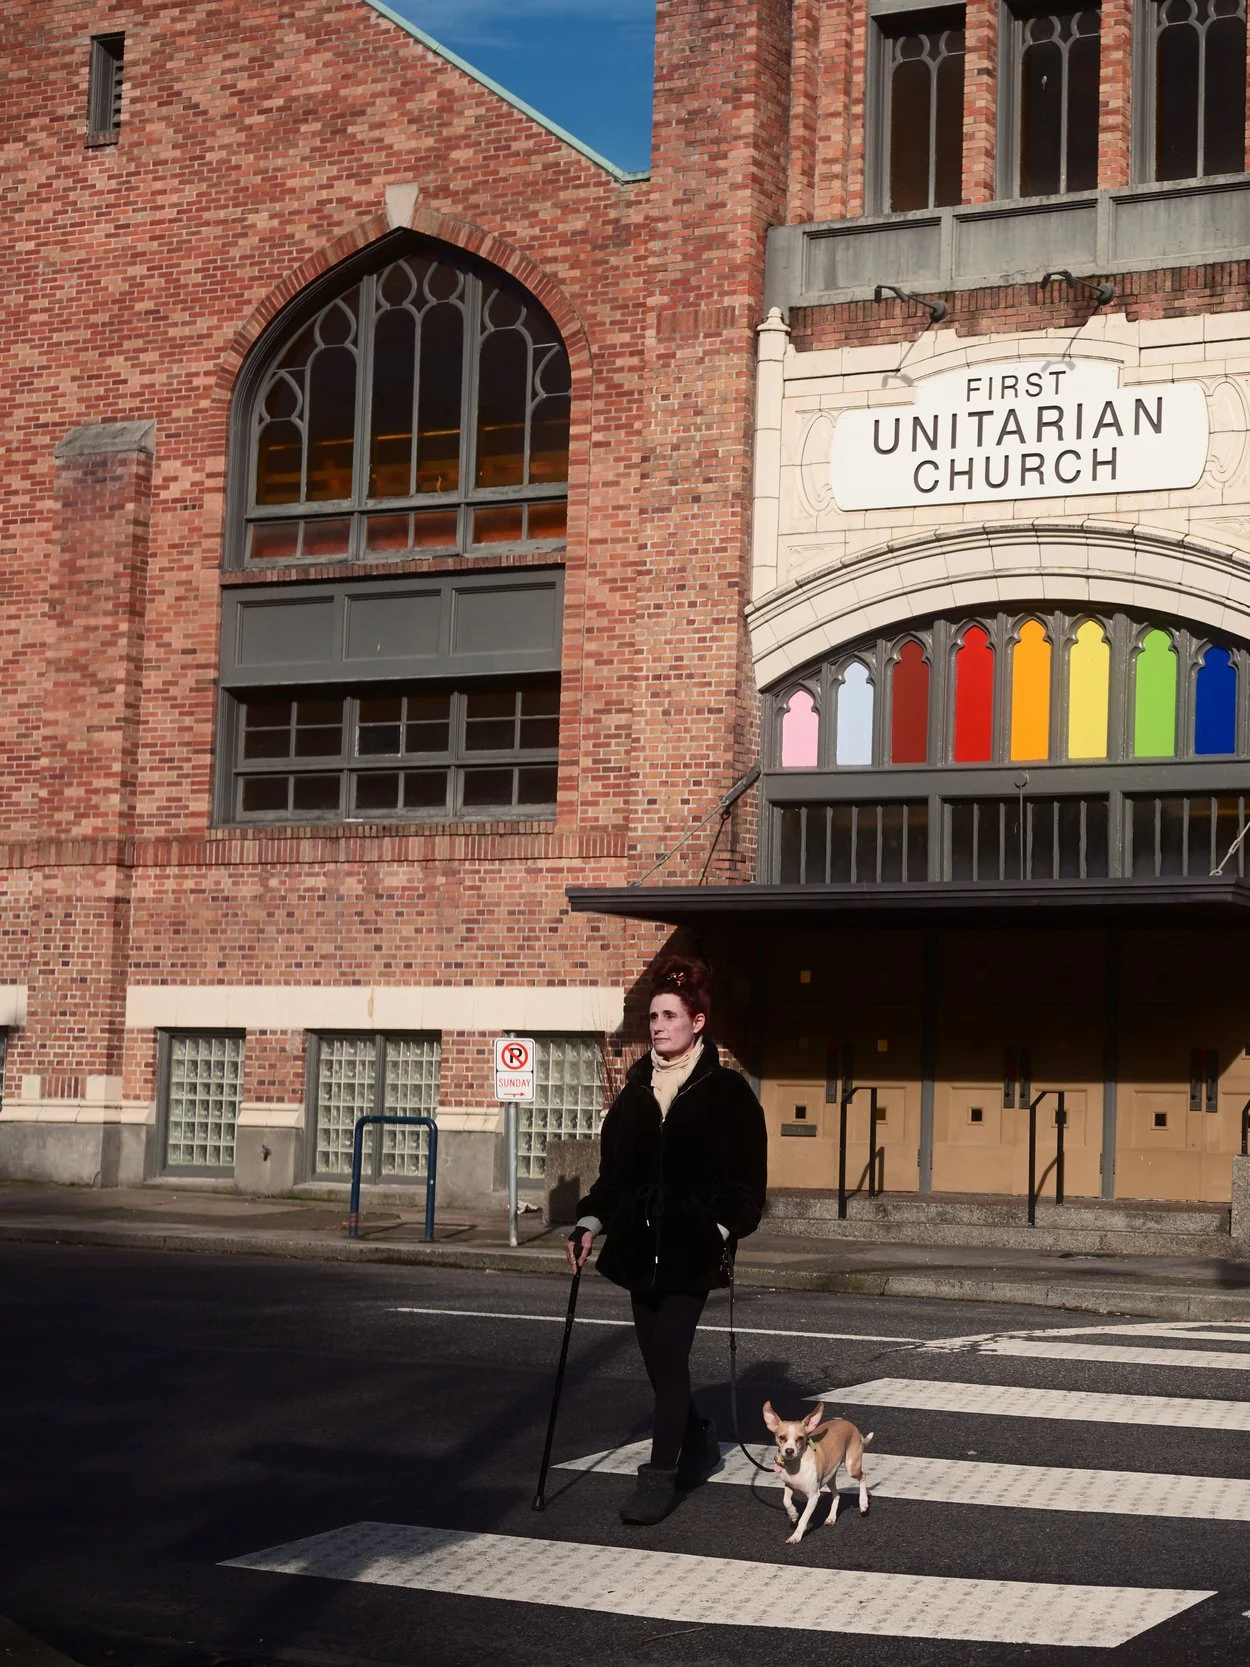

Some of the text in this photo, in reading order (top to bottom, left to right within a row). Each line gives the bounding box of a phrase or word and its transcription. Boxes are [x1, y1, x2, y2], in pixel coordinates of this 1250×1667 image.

[966, 370, 1067, 401] FIRST
[872, 396, 1163, 455] UNITARIAN
[912, 446, 1118, 494] CHURCH
[498, 1079, 531, 1088] SUNDAY
